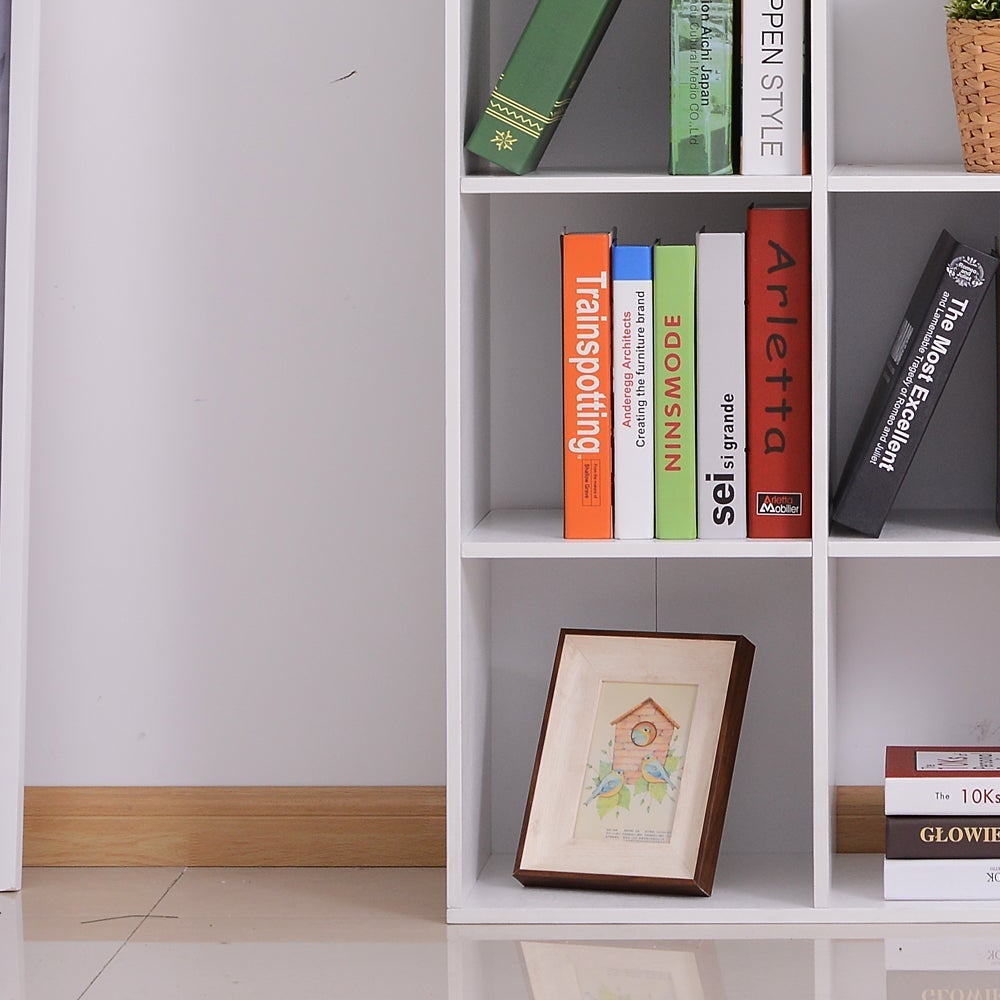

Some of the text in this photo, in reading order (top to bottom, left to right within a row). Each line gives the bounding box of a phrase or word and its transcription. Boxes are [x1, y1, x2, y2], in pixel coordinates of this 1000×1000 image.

[700, 25, 713, 61] Aichi
[699, 65, 713, 107] Japan
[760, 73, 784, 157] STYLE
[938, 290, 950, 308] and
[940, 298, 969, 332] The
[763, 239, 798, 455] Arletta
[918, 308, 945, 354] Lamentable
[568, 271, 606, 454] Trainspotting
[622, 311, 634, 429] Anderegg Architects
[635, 290, 648, 448] Creating the furniture brand
[902, 355, 925, 387] Tragedy
[917, 334, 952, 383] Most
[664, 314, 681, 472] NINSMODE
[887, 396, 906, 426] Romeo
[900, 386, 908, 400] of
[878, 384, 930, 472] Excellent
[879, 425, 891, 443] and
[705, 392, 738, 526] sei si grande
[869, 442, 884, 465] Juliet
[934, 792, 950, 800] The
